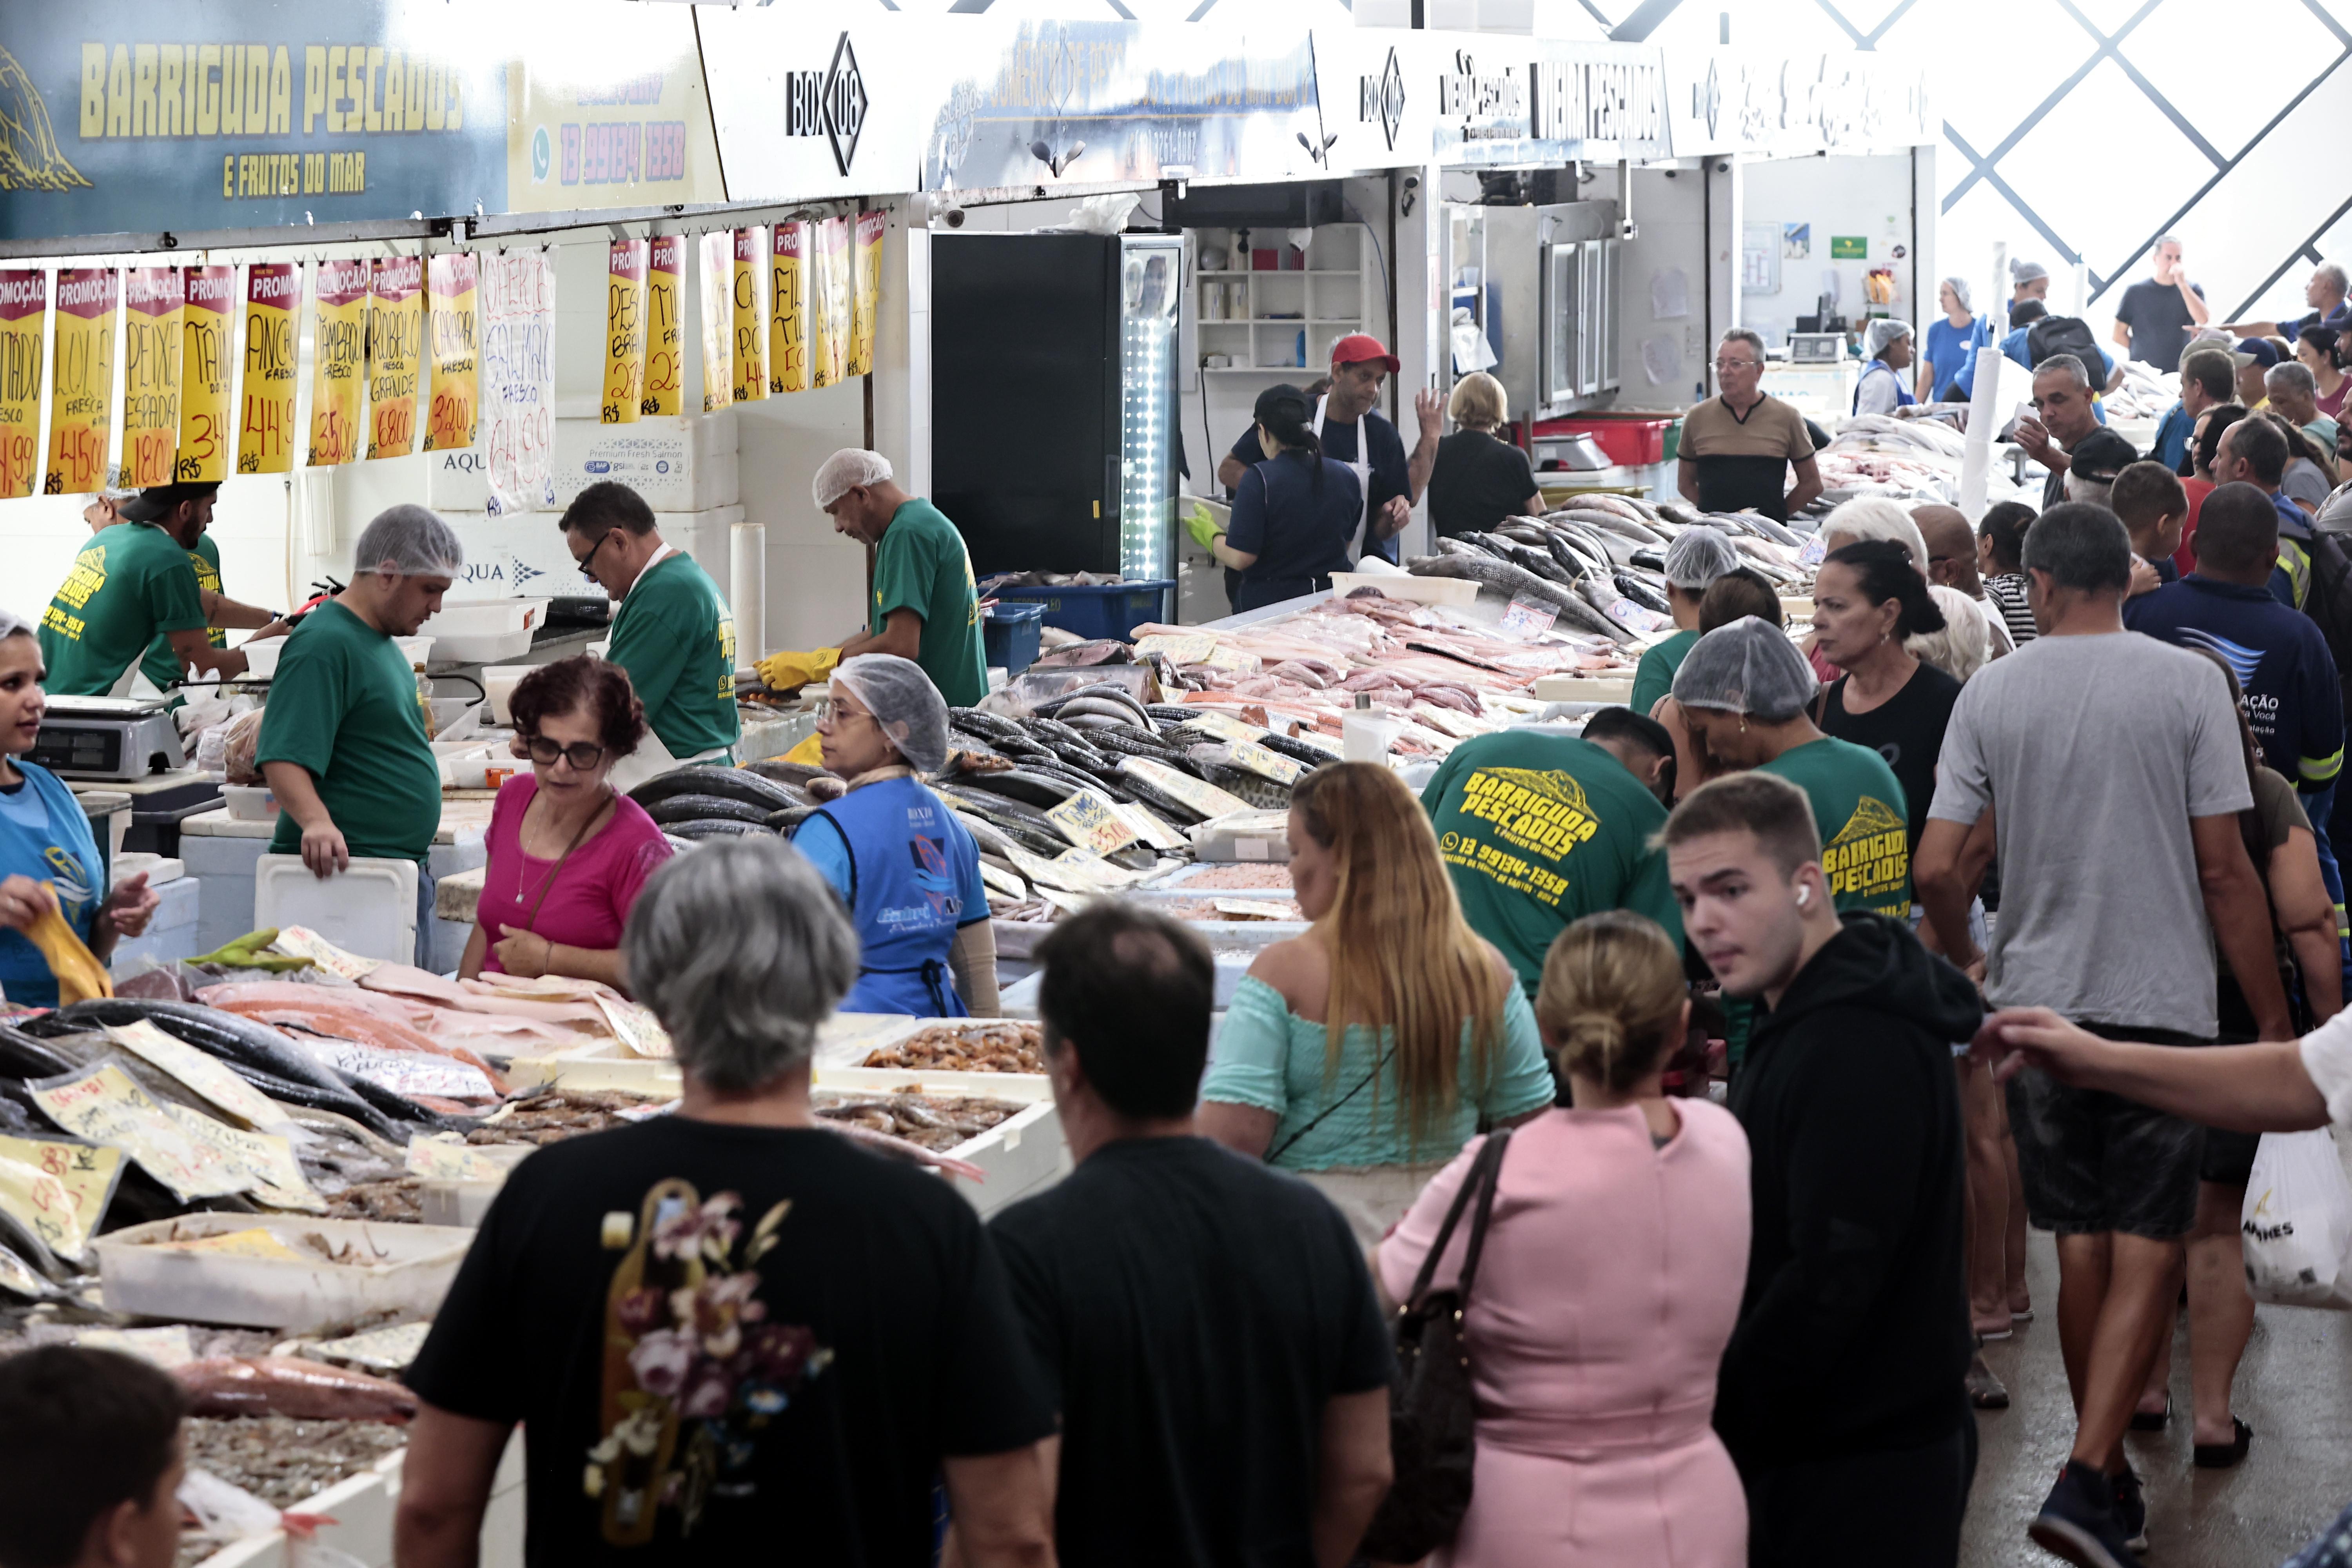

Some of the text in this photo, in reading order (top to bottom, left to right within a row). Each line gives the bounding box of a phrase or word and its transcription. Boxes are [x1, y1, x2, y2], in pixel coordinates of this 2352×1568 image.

[80, 43, 463, 138] BARRIGUDA PESCADOS
[786, 69, 859, 136] BOX 08
[935, 87, 983, 128] ESCADOS
[1360, 75, 1380, 122] BOX
[224, 151, 365, 198] E FRUTOS DO MAR
[561, 120, 685, 186] 13 99134 1358
[59, 276, 117, 307] PROMOÇÃO
[128, 276, 185, 304] PROMOÇÃO
[316, 267, 367, 294] PROMOÇÃO
[373, 263, 421, 291] PROMOÇÃO
[603, 401, 619, 423] R$
[590, 449, 626, 458] Premium
[460, 564, 504, 583] QUA
[1459, 792, 1577, 856] PESCADOS
[1463, 771, 1598, 843] BARRIGUDA
[1458, 837, 1569, 896] 13 99134-1358
